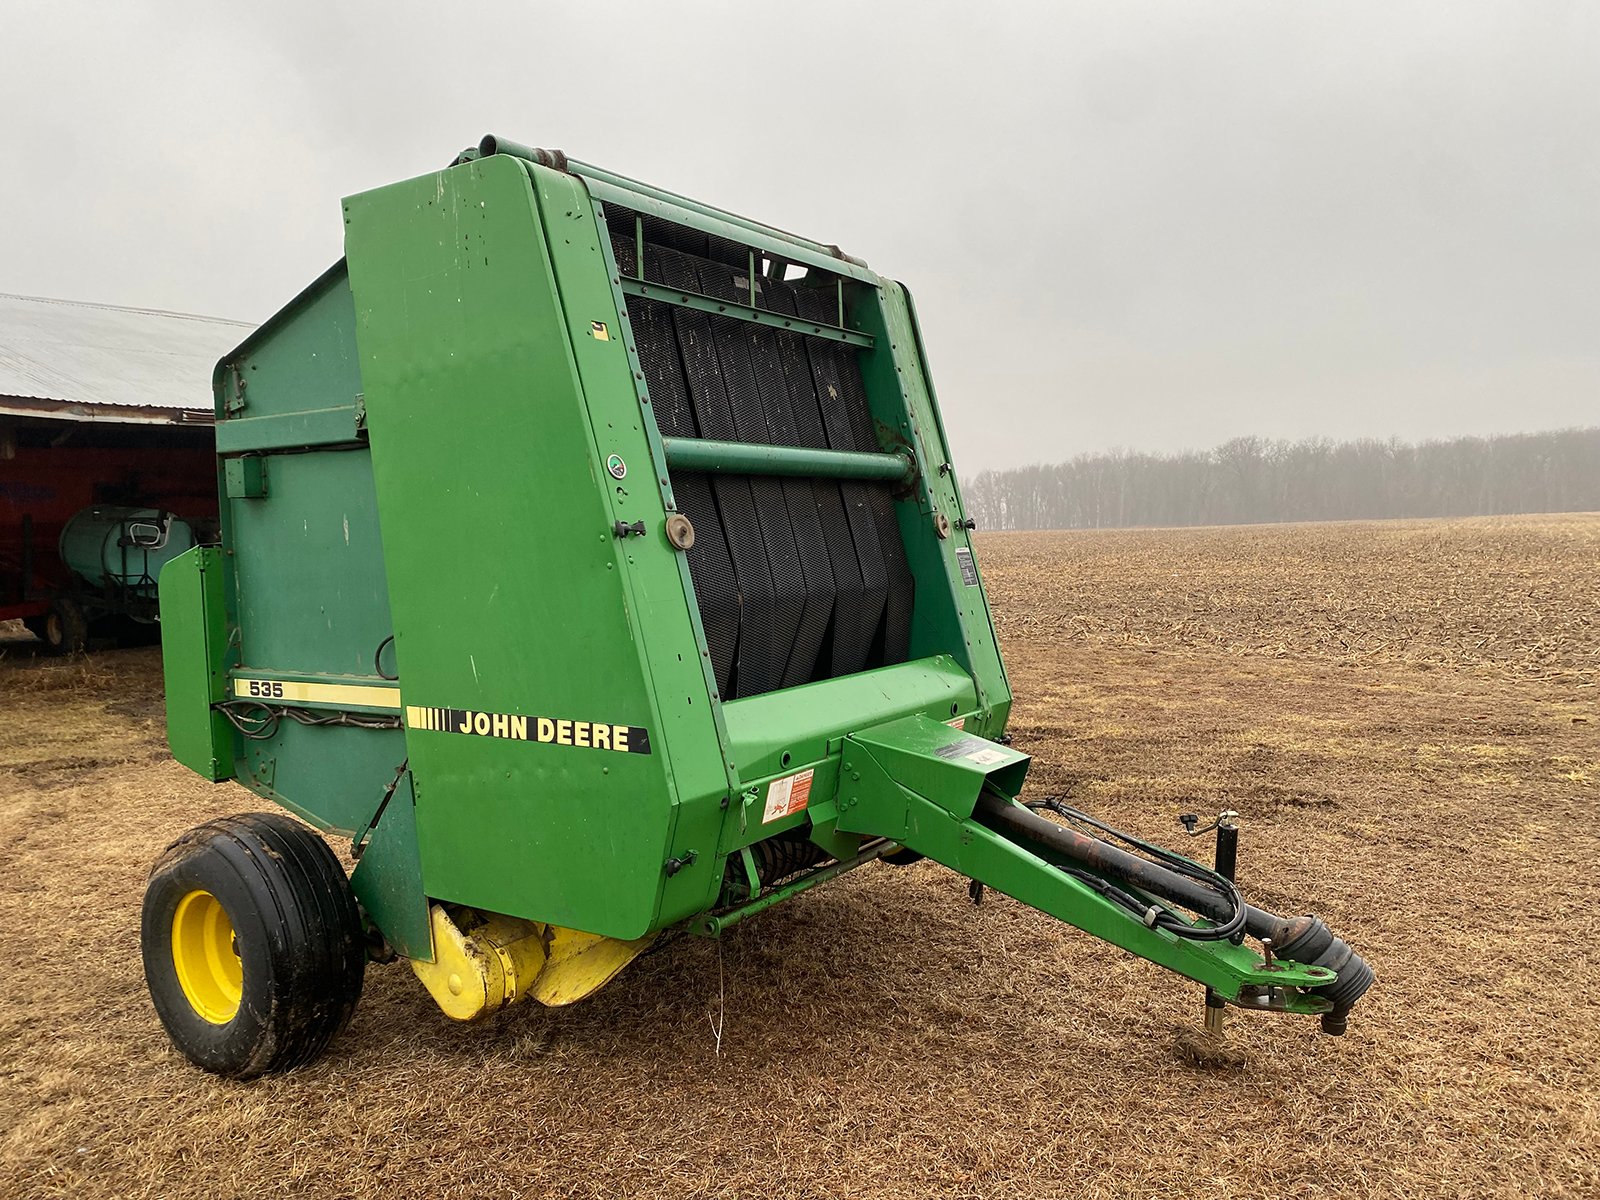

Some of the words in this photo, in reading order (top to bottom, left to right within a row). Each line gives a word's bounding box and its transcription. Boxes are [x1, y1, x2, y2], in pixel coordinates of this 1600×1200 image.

[250, 681, 283, 697] 535
[459, 711, 527, 740] JOHN
[537, 718, 629, 752] DEERE
